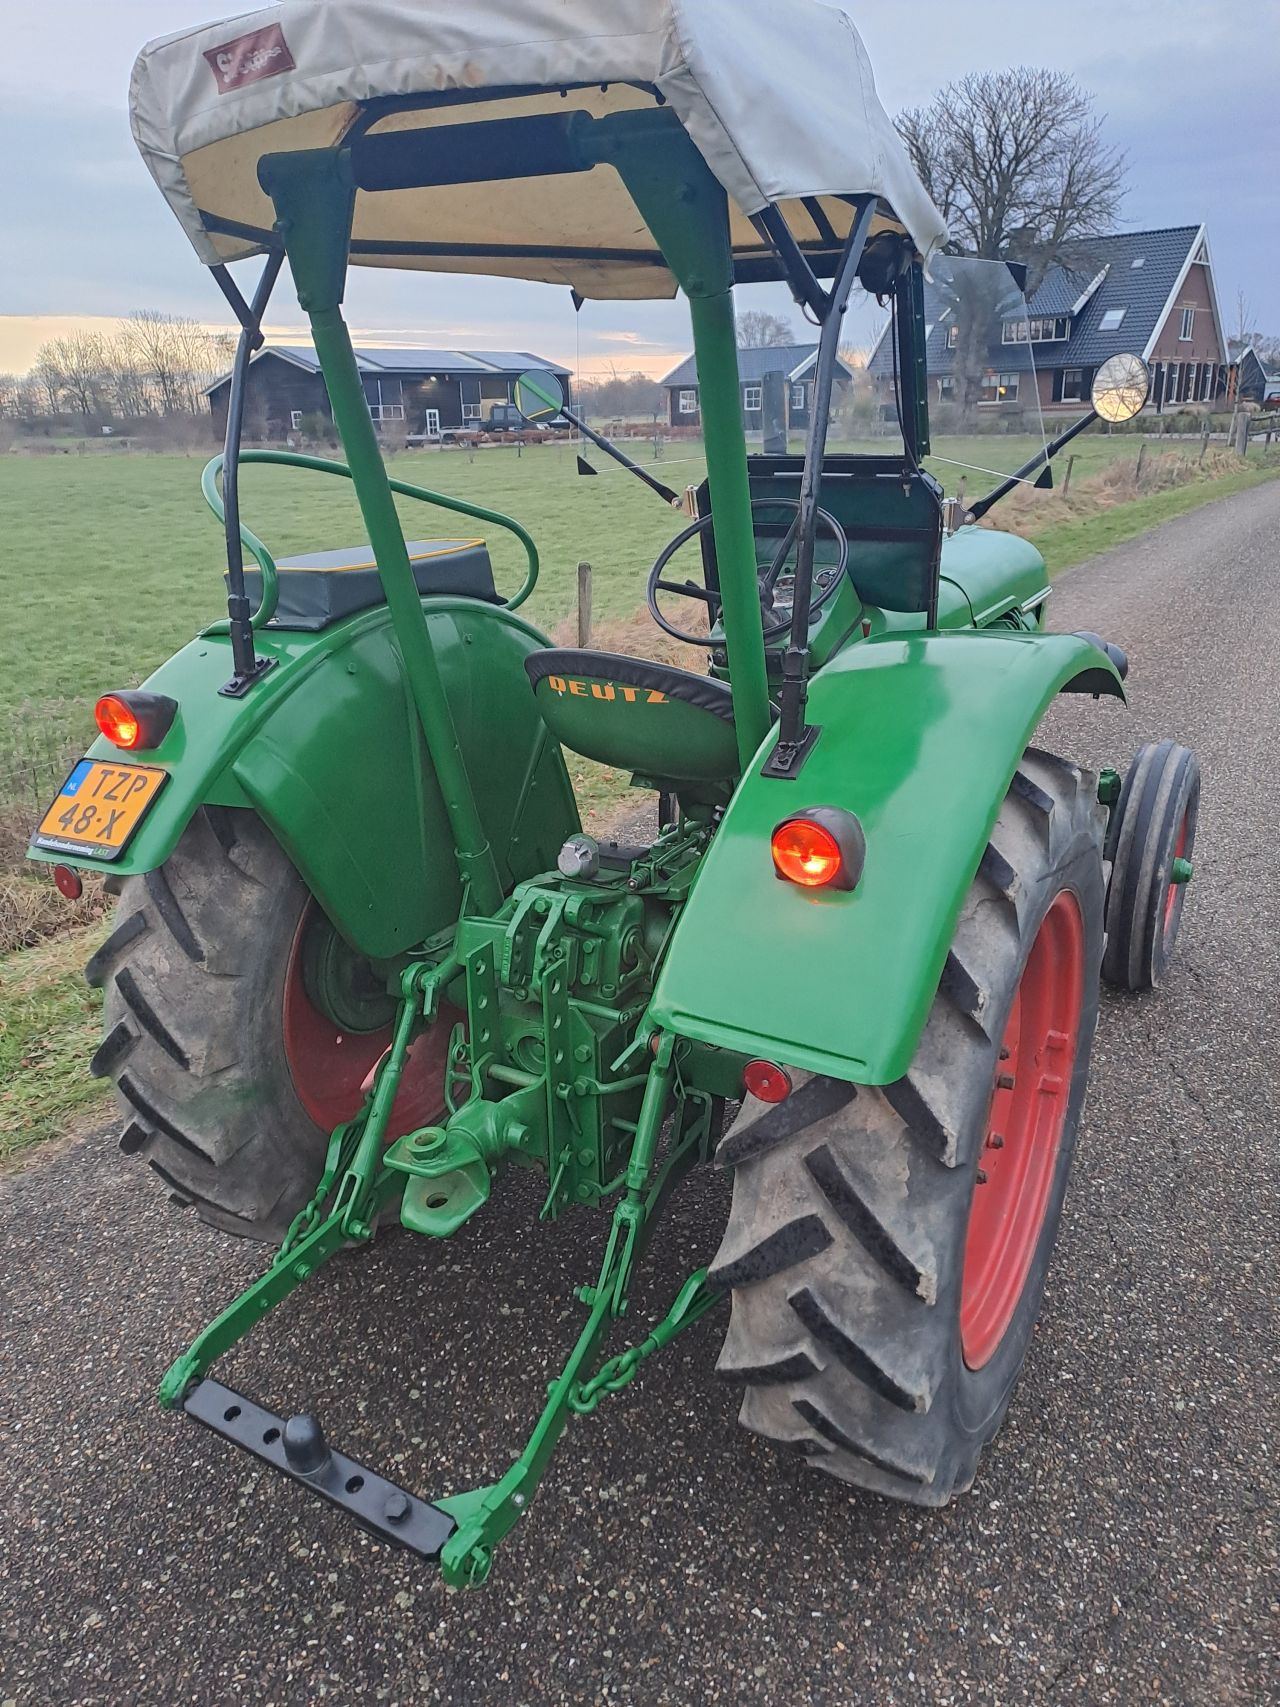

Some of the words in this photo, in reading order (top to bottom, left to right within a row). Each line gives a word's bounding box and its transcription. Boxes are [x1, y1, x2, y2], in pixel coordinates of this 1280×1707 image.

[548, 675, 670, 703] DEUTZ
[67, 782, 78, 791] NL
[92, 769, 148, 803] TZP
